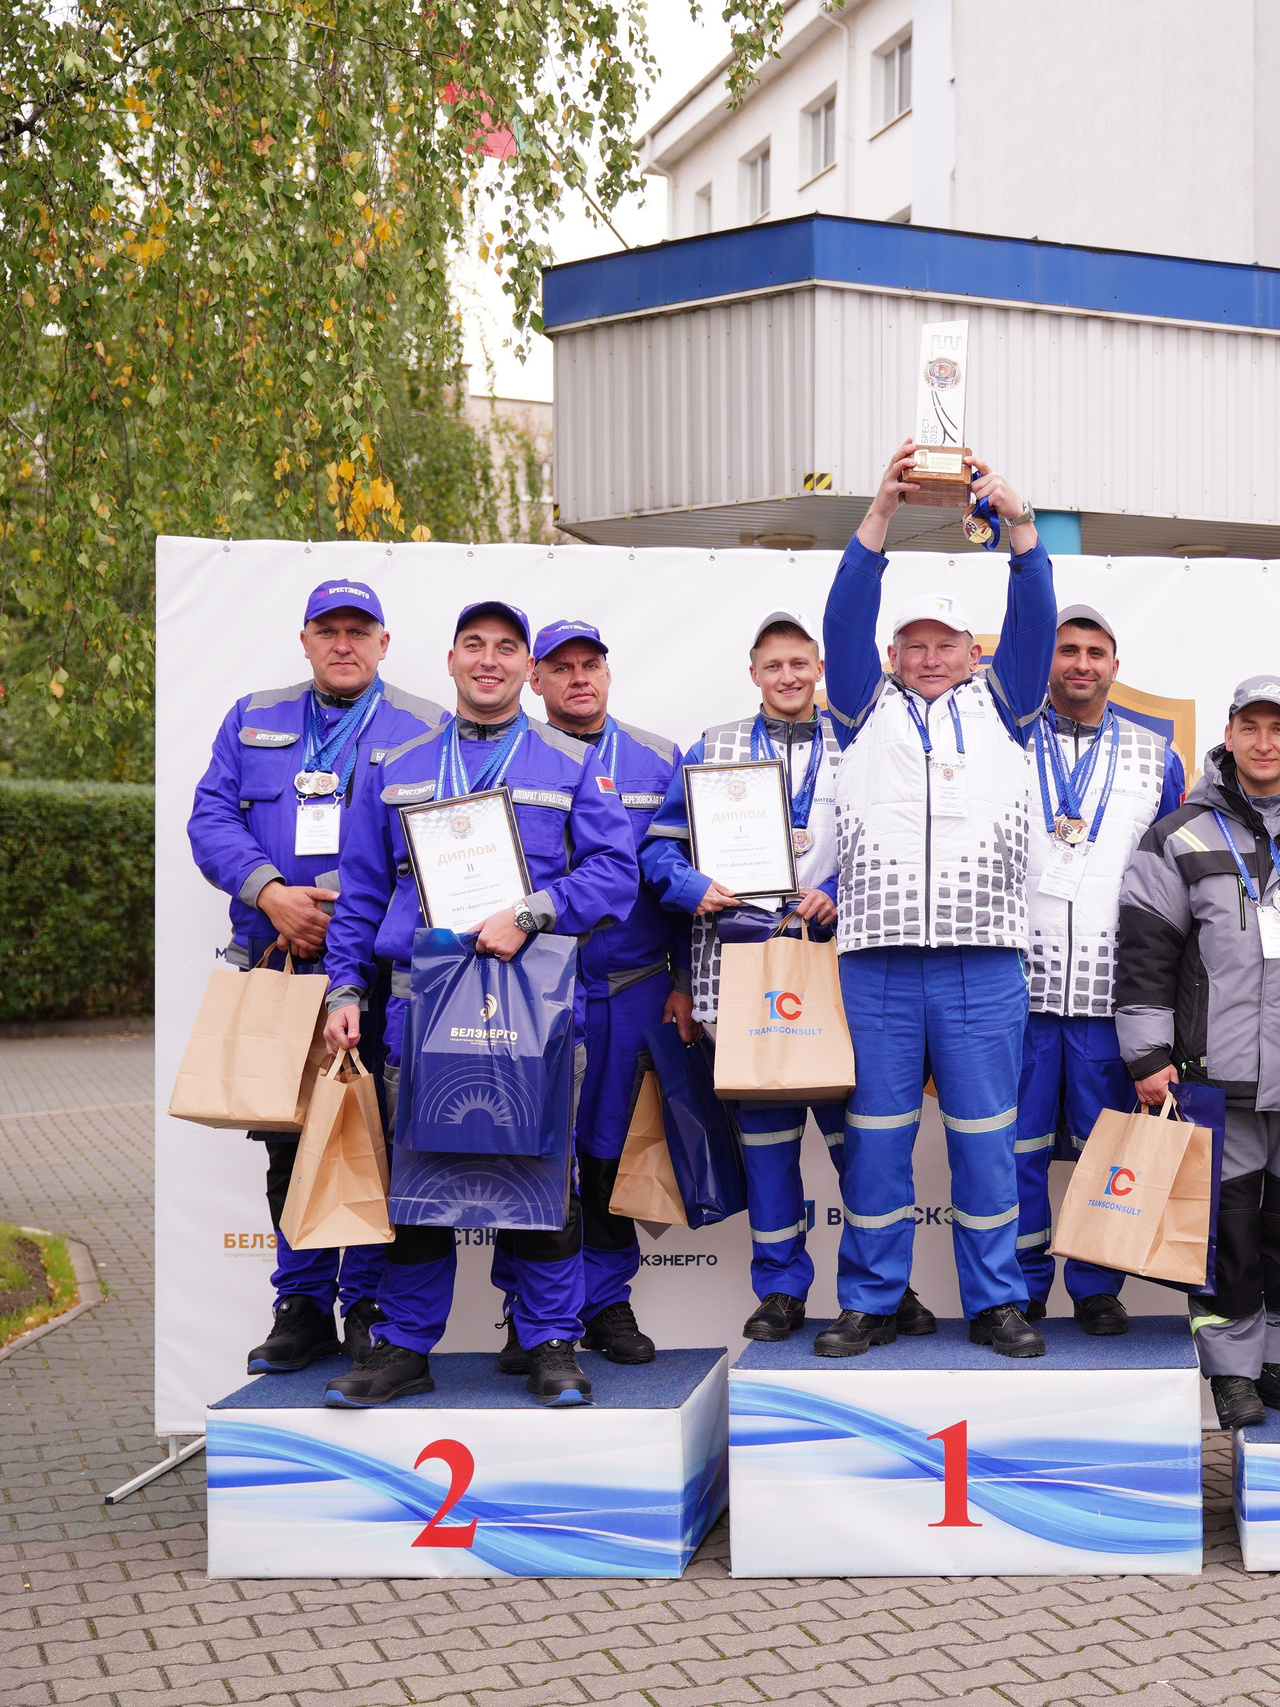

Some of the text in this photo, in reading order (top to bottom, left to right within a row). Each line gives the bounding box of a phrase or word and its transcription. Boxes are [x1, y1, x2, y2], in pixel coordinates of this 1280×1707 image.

[921, 418, 929, 444] БРЕСТ
[930, 424, 938, 445] 2025
[917, 451, 929, 469] 1
[513, 789, 537, 800] АППАРАТ
[622, 795, 659, 804] БЕРЕЗОВСКАЯ
[712, 809, 767, 824] ДИПЛОМ
[438, 843, 497, 867] ДИПЛОМ
[467, 863, 474, 873] II
[450, 1027, 518, 1041] БЕЛЭНЕРГО
[748, 1025, 823, 1036] TRANSCONSULT
[1088, 1199, 1142, 1216] TRANSCONSULT
[640, 1254, 718, 1266] КЭНЕРГО
[926, 1420, 982, 1526] 1
[412, 1439, 477, 1547] 2
